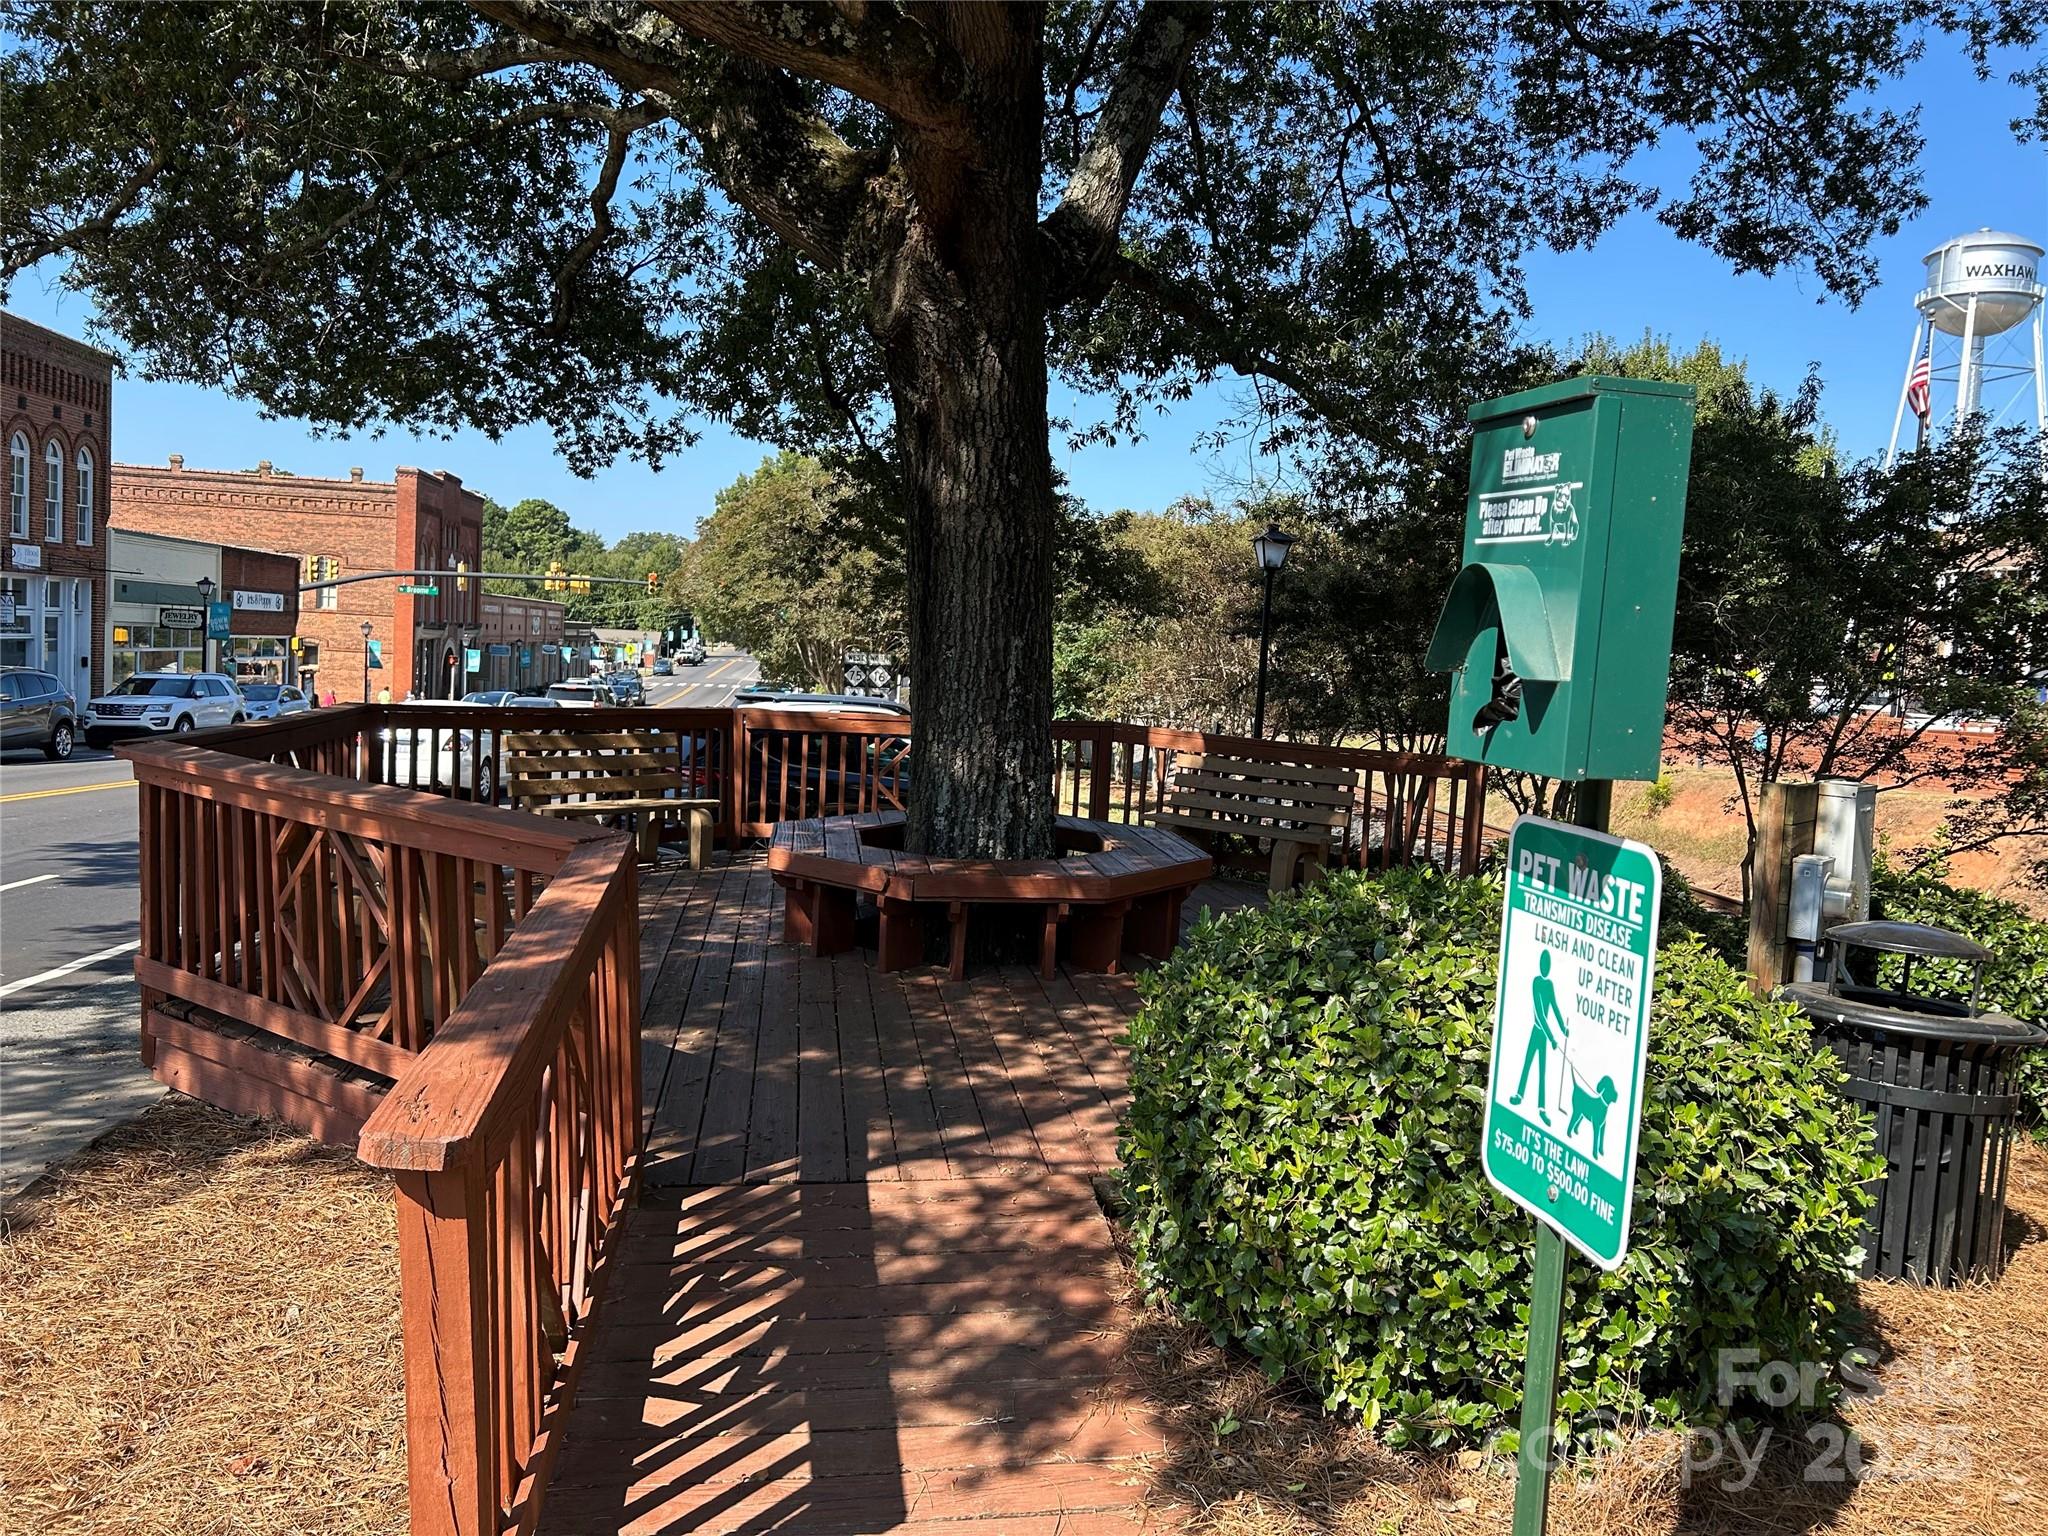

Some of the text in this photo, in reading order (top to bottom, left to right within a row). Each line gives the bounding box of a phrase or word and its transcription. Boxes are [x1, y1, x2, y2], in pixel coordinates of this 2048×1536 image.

[1966, 264, 2034, 279] WAXHAW
[1479, 496, 1548, 519] Please Clean Up
[1482, 515, 1542, 535] after your pet.
[164, 612, 199, 620] JEWELRY
[850, 670, 861, 680] 75
[875, 671, 885, 682] 16
[1518, 849, 1645, 924] PET WASTE
[1524, 892, 1632, 949] TRANSMITS DISEASE
[1535, 923, 1635, 980] LEASH AND CLEAN
[1578, 967, 1632, 1008] UP AFTER
[1576, 993, 1630, 1036] YOUR PET
[1521, 1124, 1590, 1183] IT'S THE LAW!
[1494, 1128, 1615, 1226] $75.00 TO $500.00 FINE
